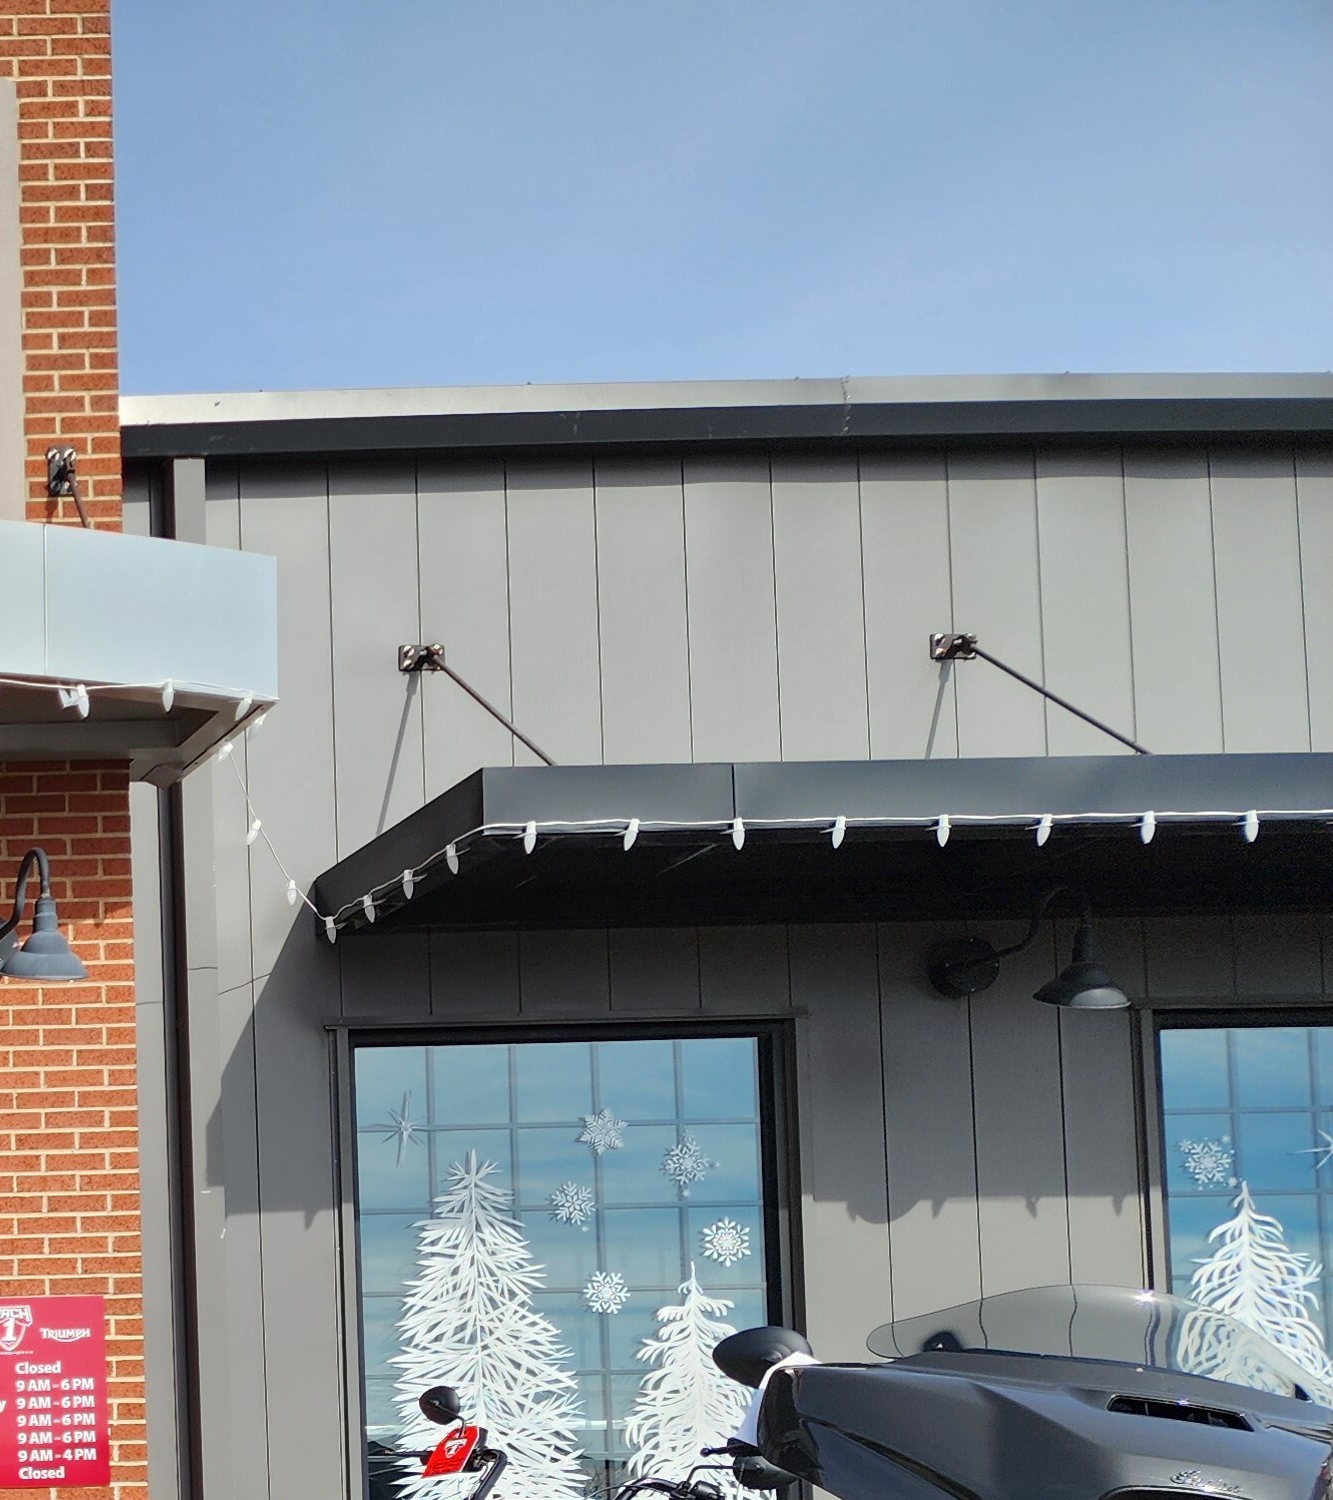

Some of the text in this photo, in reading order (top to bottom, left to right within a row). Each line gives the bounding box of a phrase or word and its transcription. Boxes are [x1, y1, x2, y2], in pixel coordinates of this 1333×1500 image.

[2, 1318, 17, 1342] 1
[39, 1327, 91, 1342] TRIUMPH
[15, 1361, 61, 1375] Closed
[15, 1380, 25, 1392] 9
[28, 1379, 51, 1391] AM
[61, 1379, 70, 1391] 6
[73, 1378, 94, 1390] PM
[17, 1398, 25, 1409] 9
[28, 1397, 51, 1409] AM
[62, 1397, 71, 1408] 6
[73, 1396, 95, 1408] PM
[17, 1415, 26, 1427] 9
[29, 1414, 52, 1426] AM
[62, 1414, 71, 1426] 6
[74, 1413, 96, 1425] PM
[18, 1433, 27, 1444] 9
[29, 1432, 53, 1444] AM
[62, 1432, 72, 1443] 6
[75, 1431, 96, 1443] PM
[18, 1450, 27, 1462] 9
[30, 1450, 53, 1461] AM
[62, 1449, 72, 1460] 4
[75, 1448, 97, 1460] PM
[19, 1466, 65, 1480] Closed
